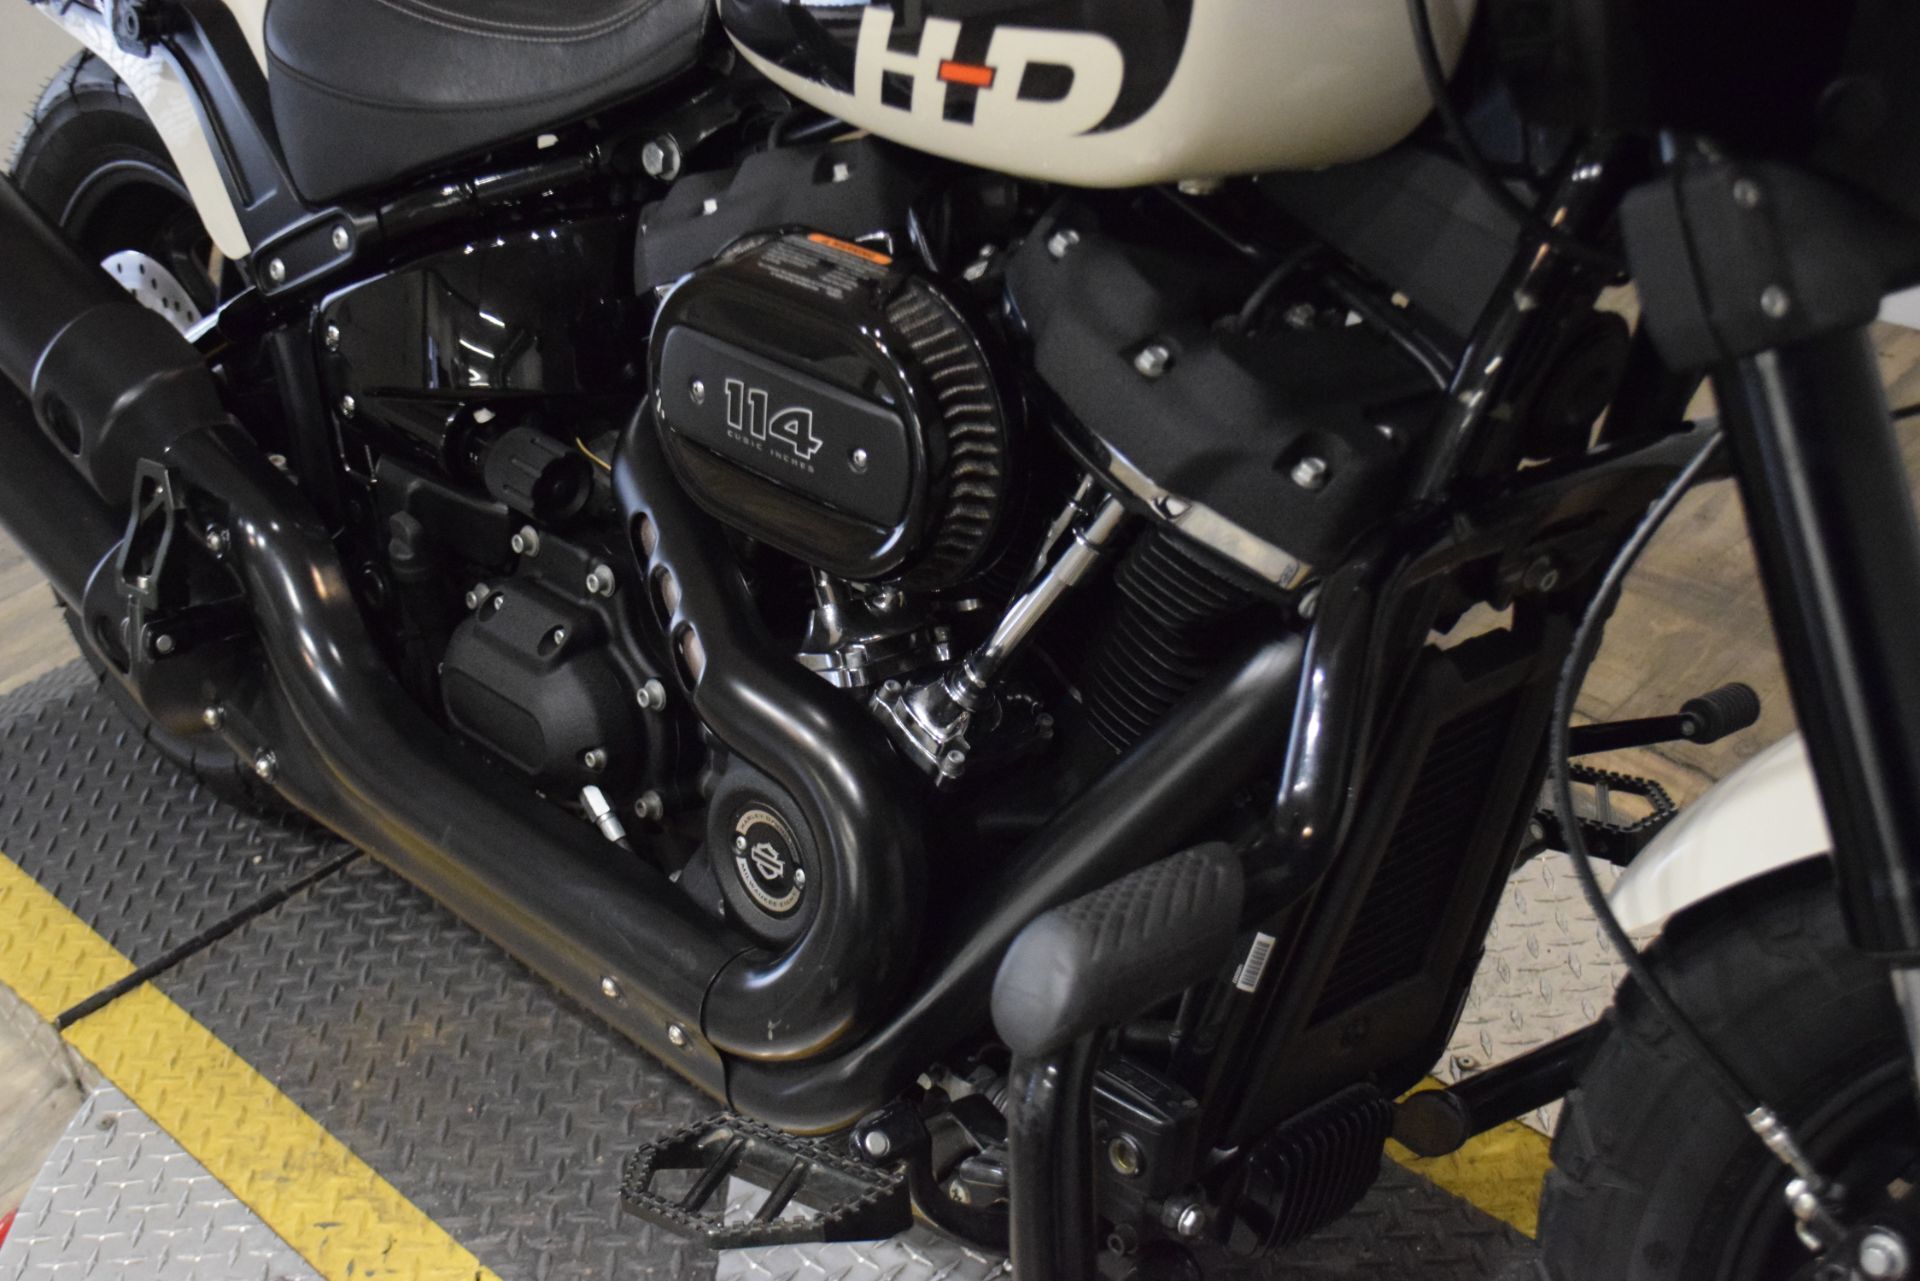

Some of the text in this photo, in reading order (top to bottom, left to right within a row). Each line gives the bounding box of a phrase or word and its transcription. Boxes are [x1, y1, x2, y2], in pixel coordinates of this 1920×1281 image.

[724, 378, 823, 460] 114
[727, 429, 815, 473] CUBIC INCHES
